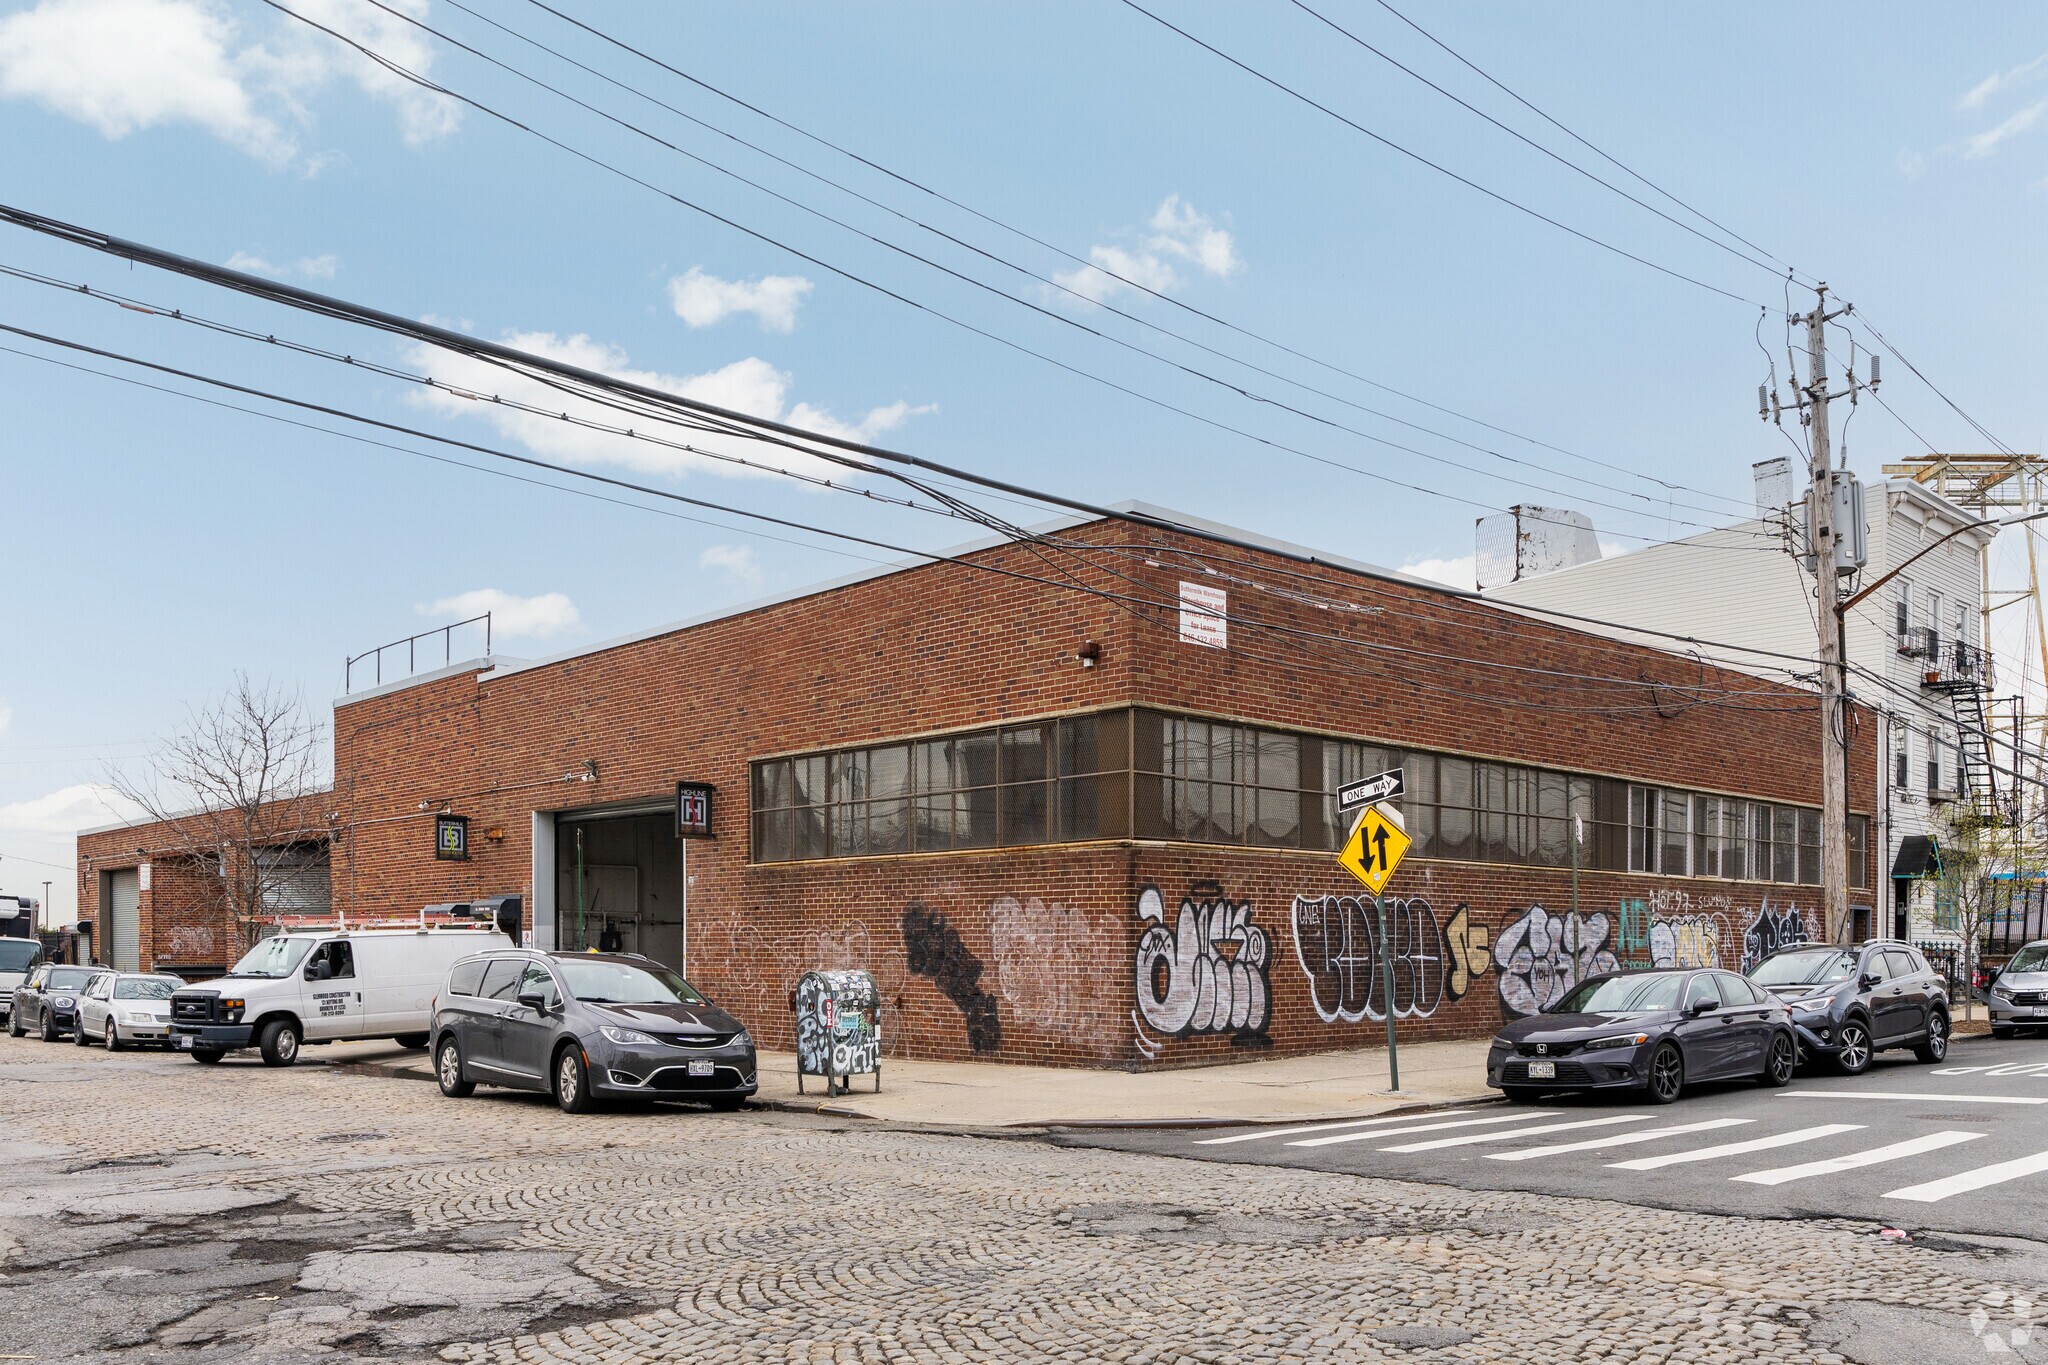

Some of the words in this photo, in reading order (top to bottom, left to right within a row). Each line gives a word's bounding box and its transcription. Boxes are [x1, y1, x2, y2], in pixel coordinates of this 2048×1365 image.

[1181, 585, 1203, 596] Buttermilk
[1203, 590, 1226, 601] Warehouse
[1213, 603, 1225, 612] and
[1191, 621, 1199, 630] for
[1200, 623, 1217, 633] Lease
[681, 789, 707, 797] HIGHLINE
[1347, 788, 1366, 801] ONE
[1373, 779, 1392, 794] WAY
[686, 801, 702, 820] H
[443, 830, 460, 846] B
[329, 991, 351, 999] CONSTRUCTION
